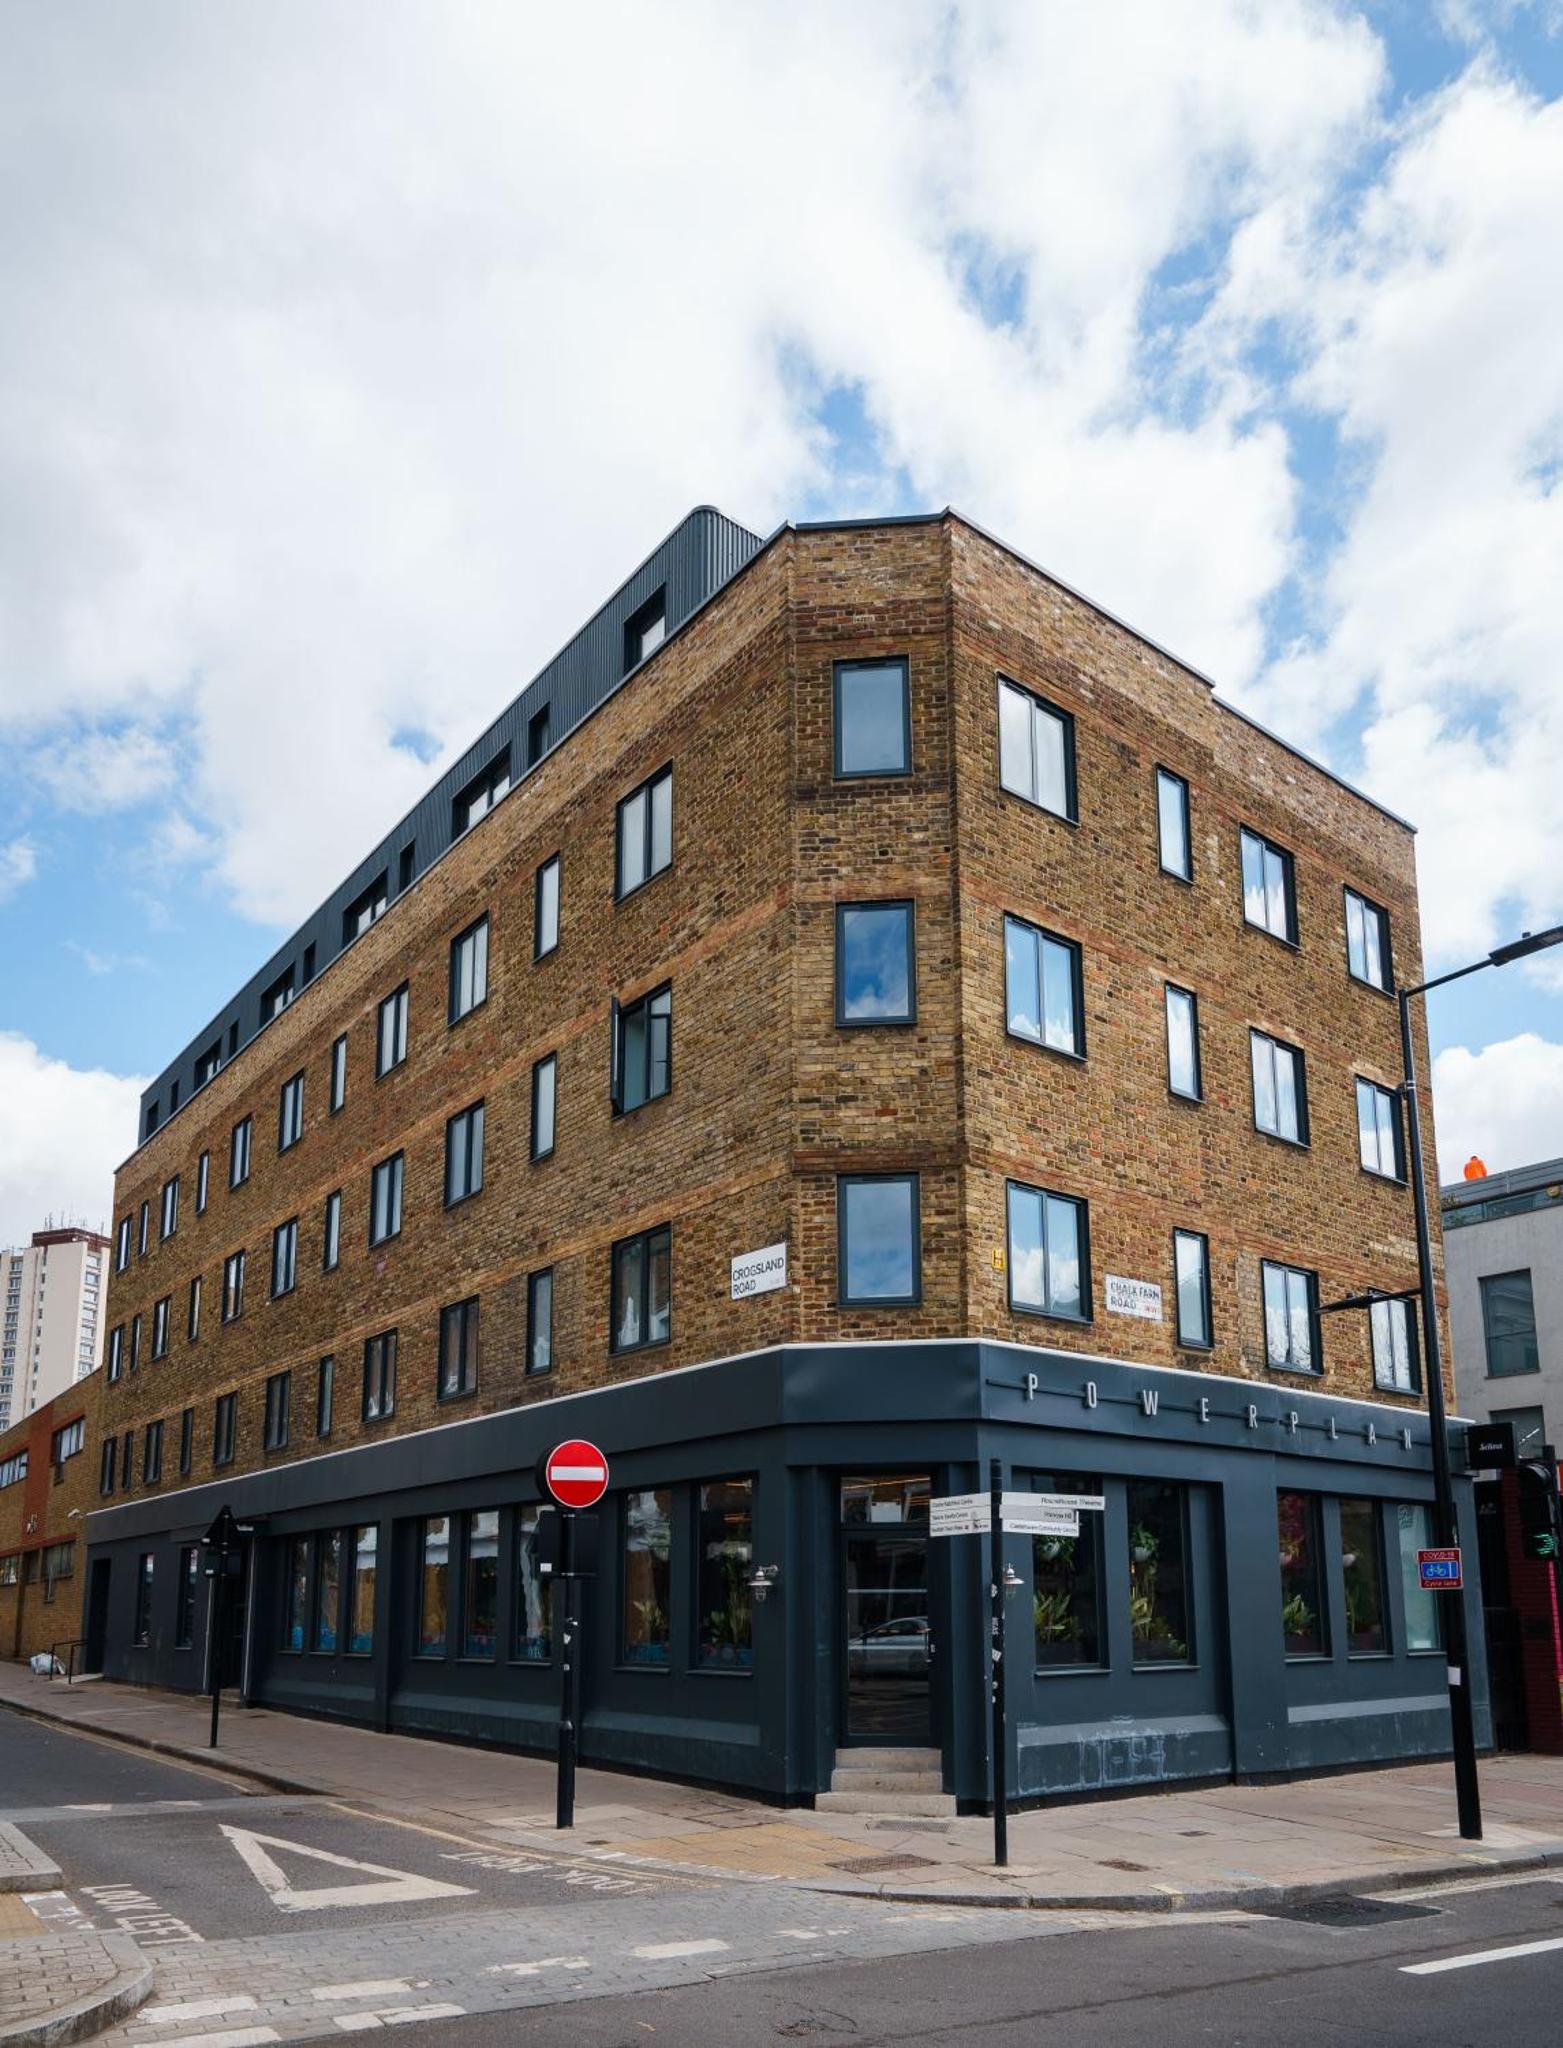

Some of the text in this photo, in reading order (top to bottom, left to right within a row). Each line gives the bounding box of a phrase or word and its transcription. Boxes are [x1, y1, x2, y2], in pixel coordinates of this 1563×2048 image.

[732, 1257, 785, 1281] CROGSLAND
[733, 1280, 757, 1295] ROAD
[1110, 1295, 1137, 1309] ROAD
[1024, 1372, 1414, 1451] POWERPLAN
[79, 1883, 206, 1945] LOOK LEFT
